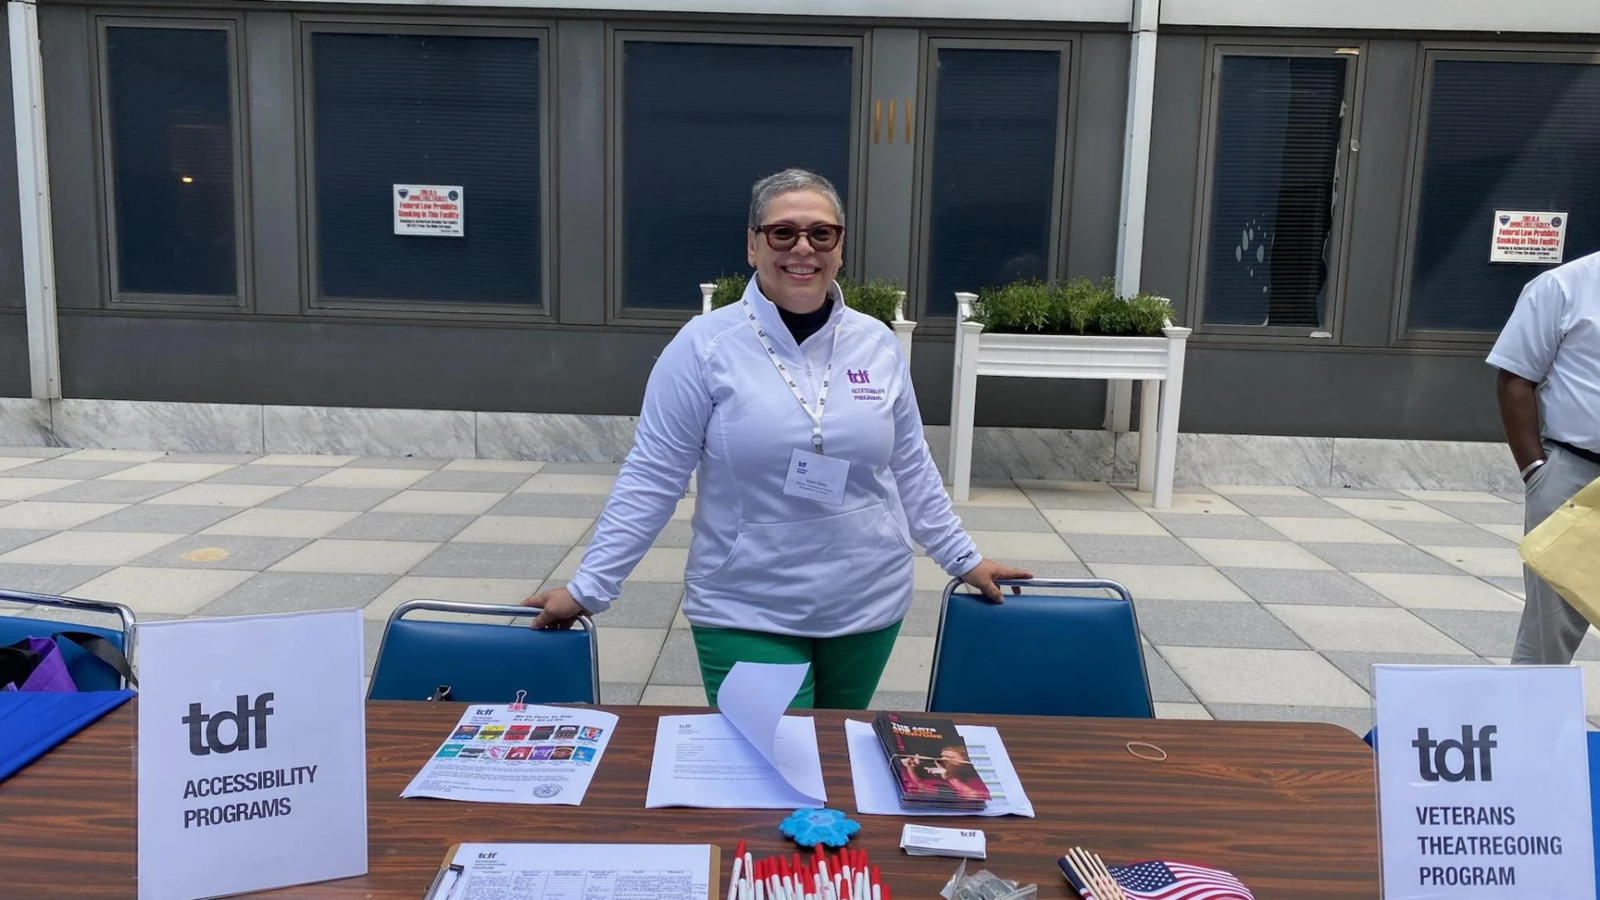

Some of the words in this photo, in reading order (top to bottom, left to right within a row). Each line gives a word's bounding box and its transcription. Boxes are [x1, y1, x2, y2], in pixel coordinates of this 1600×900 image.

[847, 369, 870, 383] tdf
[182, 692, 274, 755] tdf
[1412, 725, 1497, 782] tdf
[183, 765, 317, 799] ACCESSIBILITY
[184, 797, 292, 828] PROGRAMS
[1416, 806, 1516, 826] VETERANS
[1418, 836, 1562, 855] THEATREGOING
[1419, 867, 1516, 886] PROGRAM
